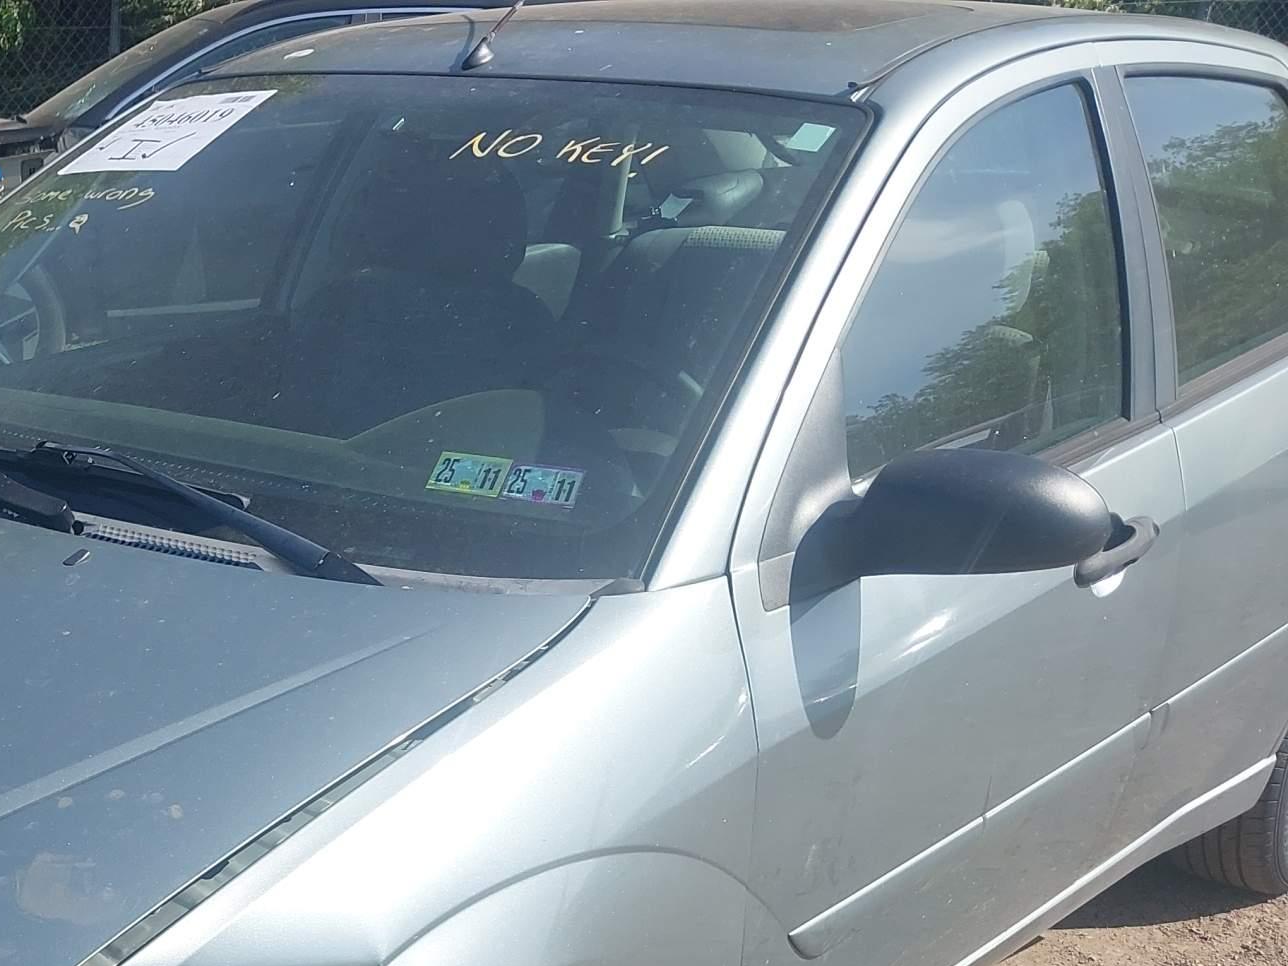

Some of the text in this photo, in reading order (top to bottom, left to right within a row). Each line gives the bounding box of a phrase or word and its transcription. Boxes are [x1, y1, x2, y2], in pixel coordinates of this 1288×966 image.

[448, 129, 543, 160] NO
[83, 187, 155, 210] wrong
[435, 457, 502, 490] 25 11
[506, 468, 577, 502] 25 11
